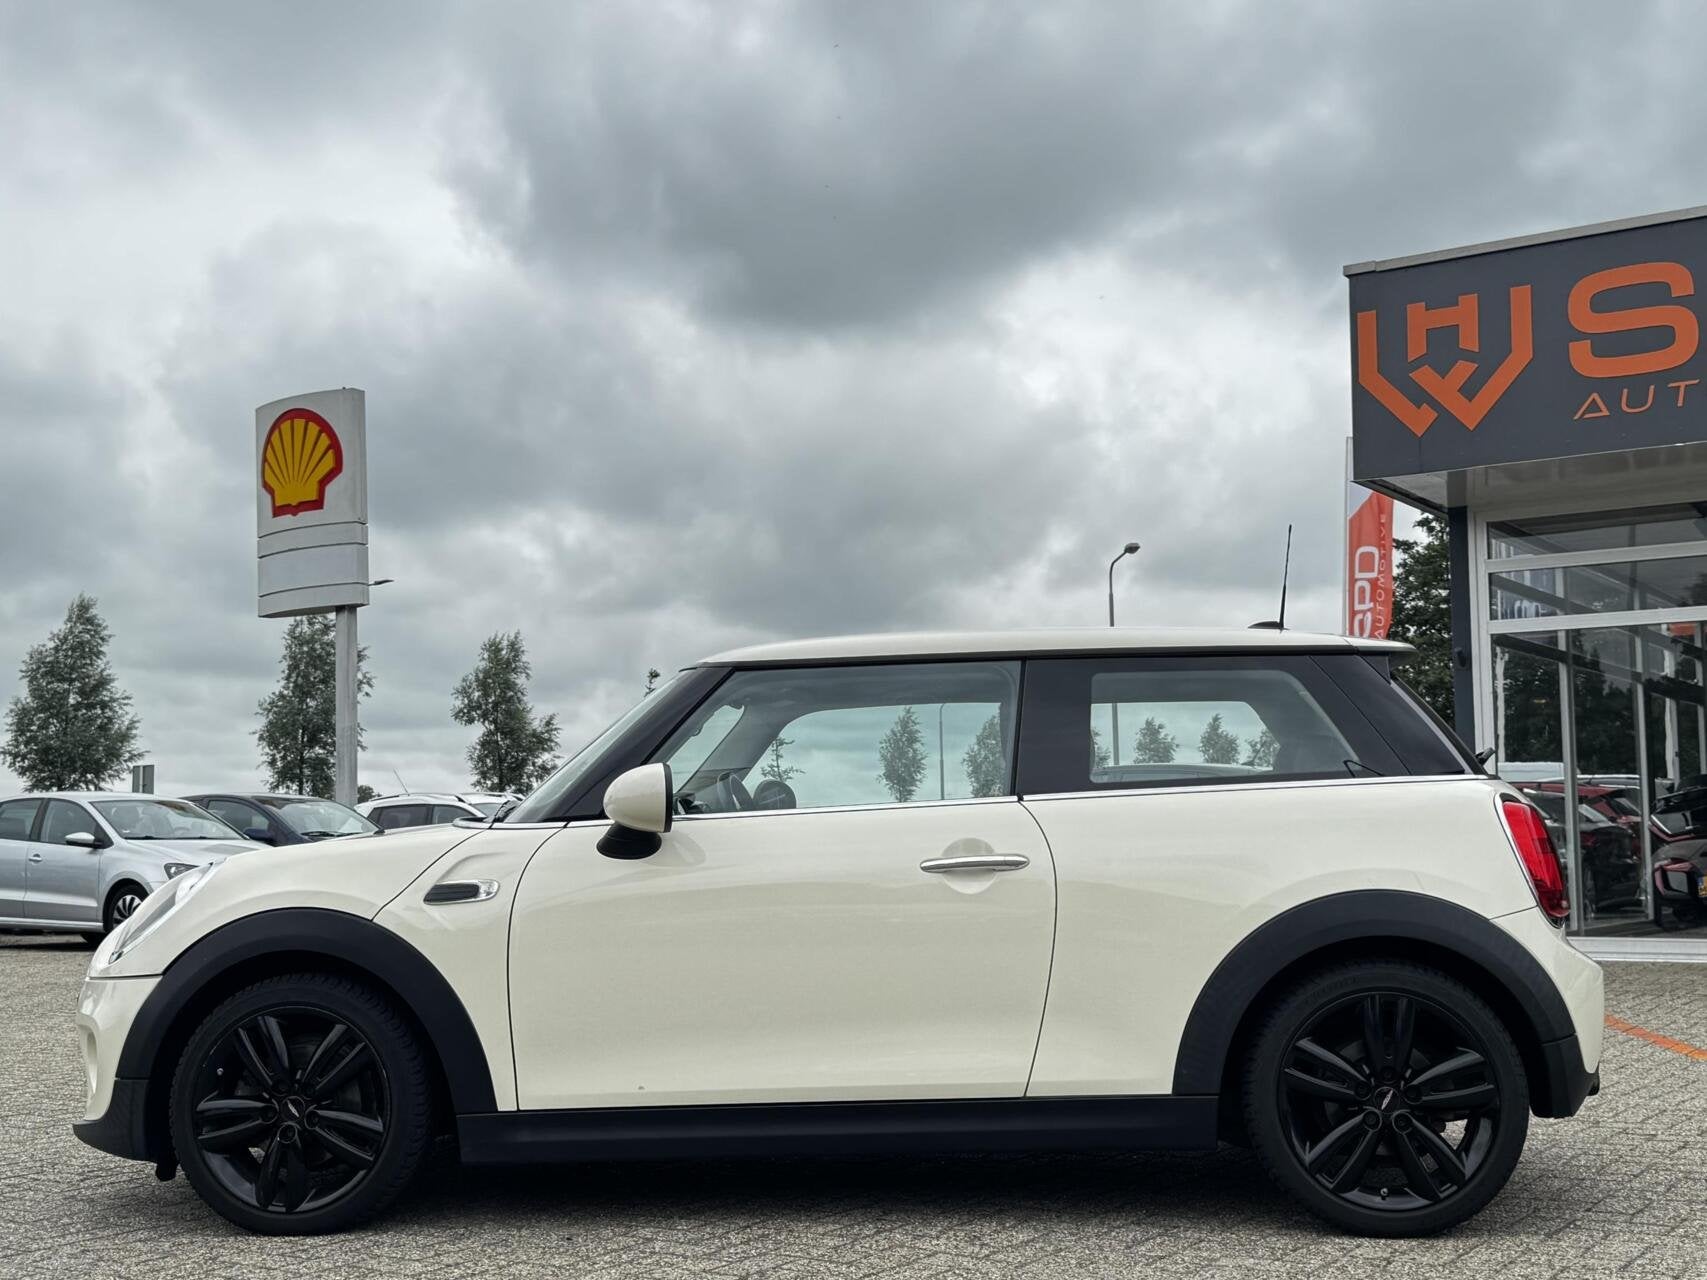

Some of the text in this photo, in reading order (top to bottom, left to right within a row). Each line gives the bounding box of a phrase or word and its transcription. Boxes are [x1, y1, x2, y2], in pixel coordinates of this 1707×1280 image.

[1572, 378, 1701, 420] AUT
[1353, 546, 1380, 640] SPD
[1374, 512, 1387, 640] AUTOMOTIVE
